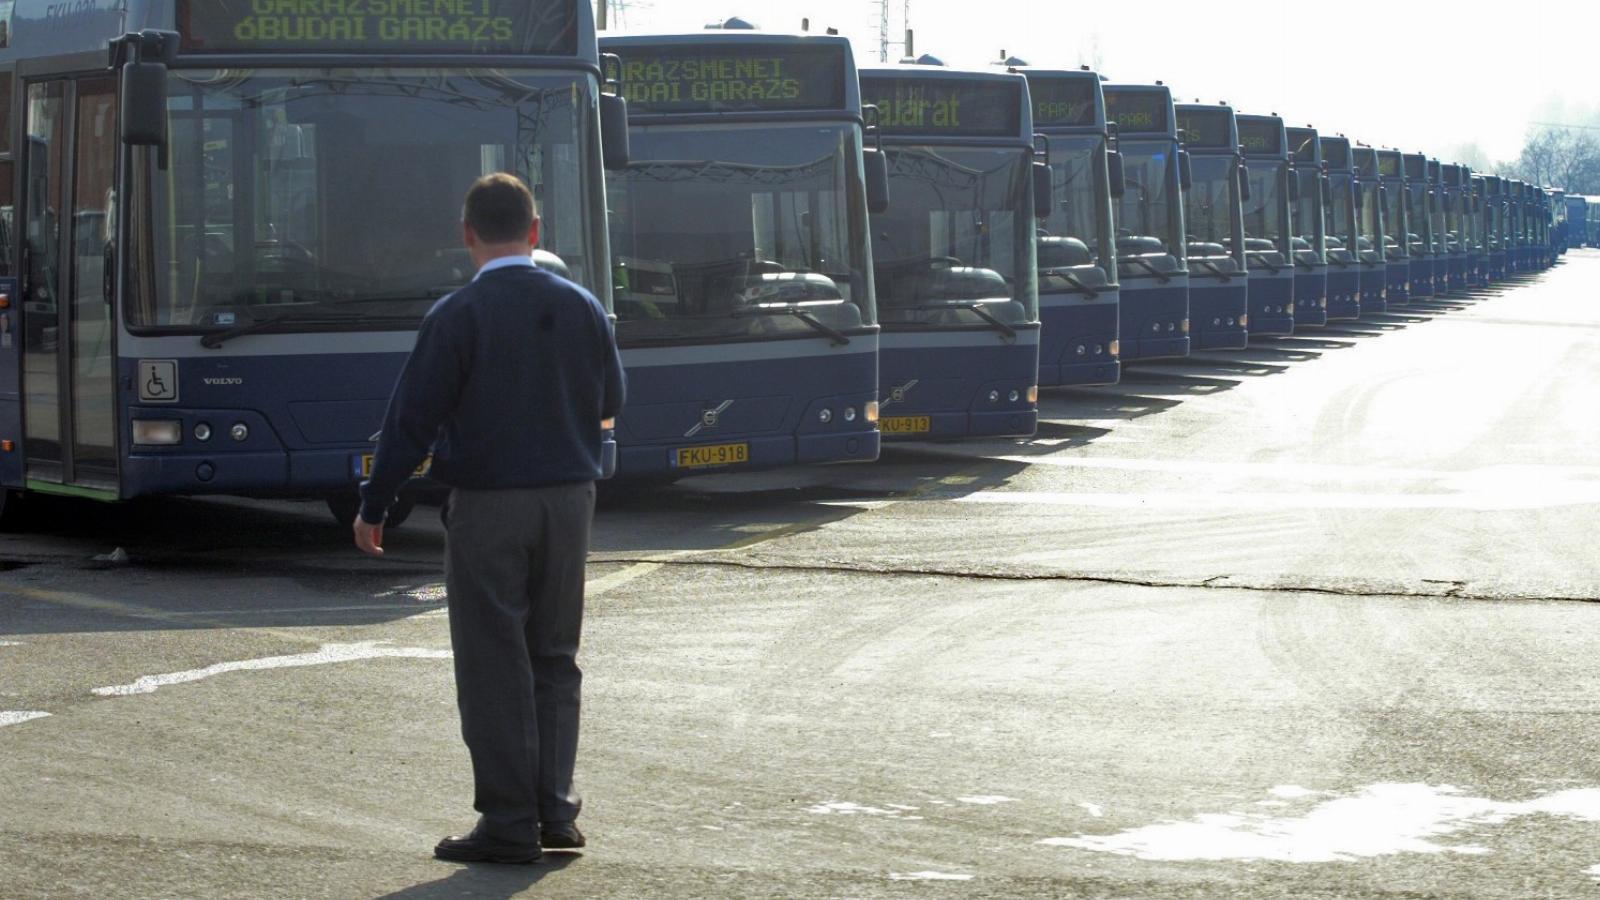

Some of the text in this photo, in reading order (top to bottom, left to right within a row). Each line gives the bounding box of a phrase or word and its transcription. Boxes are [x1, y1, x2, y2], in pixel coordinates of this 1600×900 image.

[203, 377, 242, 385] VOLVO
[881, 417, 929, 431] KU-913
[680, 445, 744, 465] FKU-918
